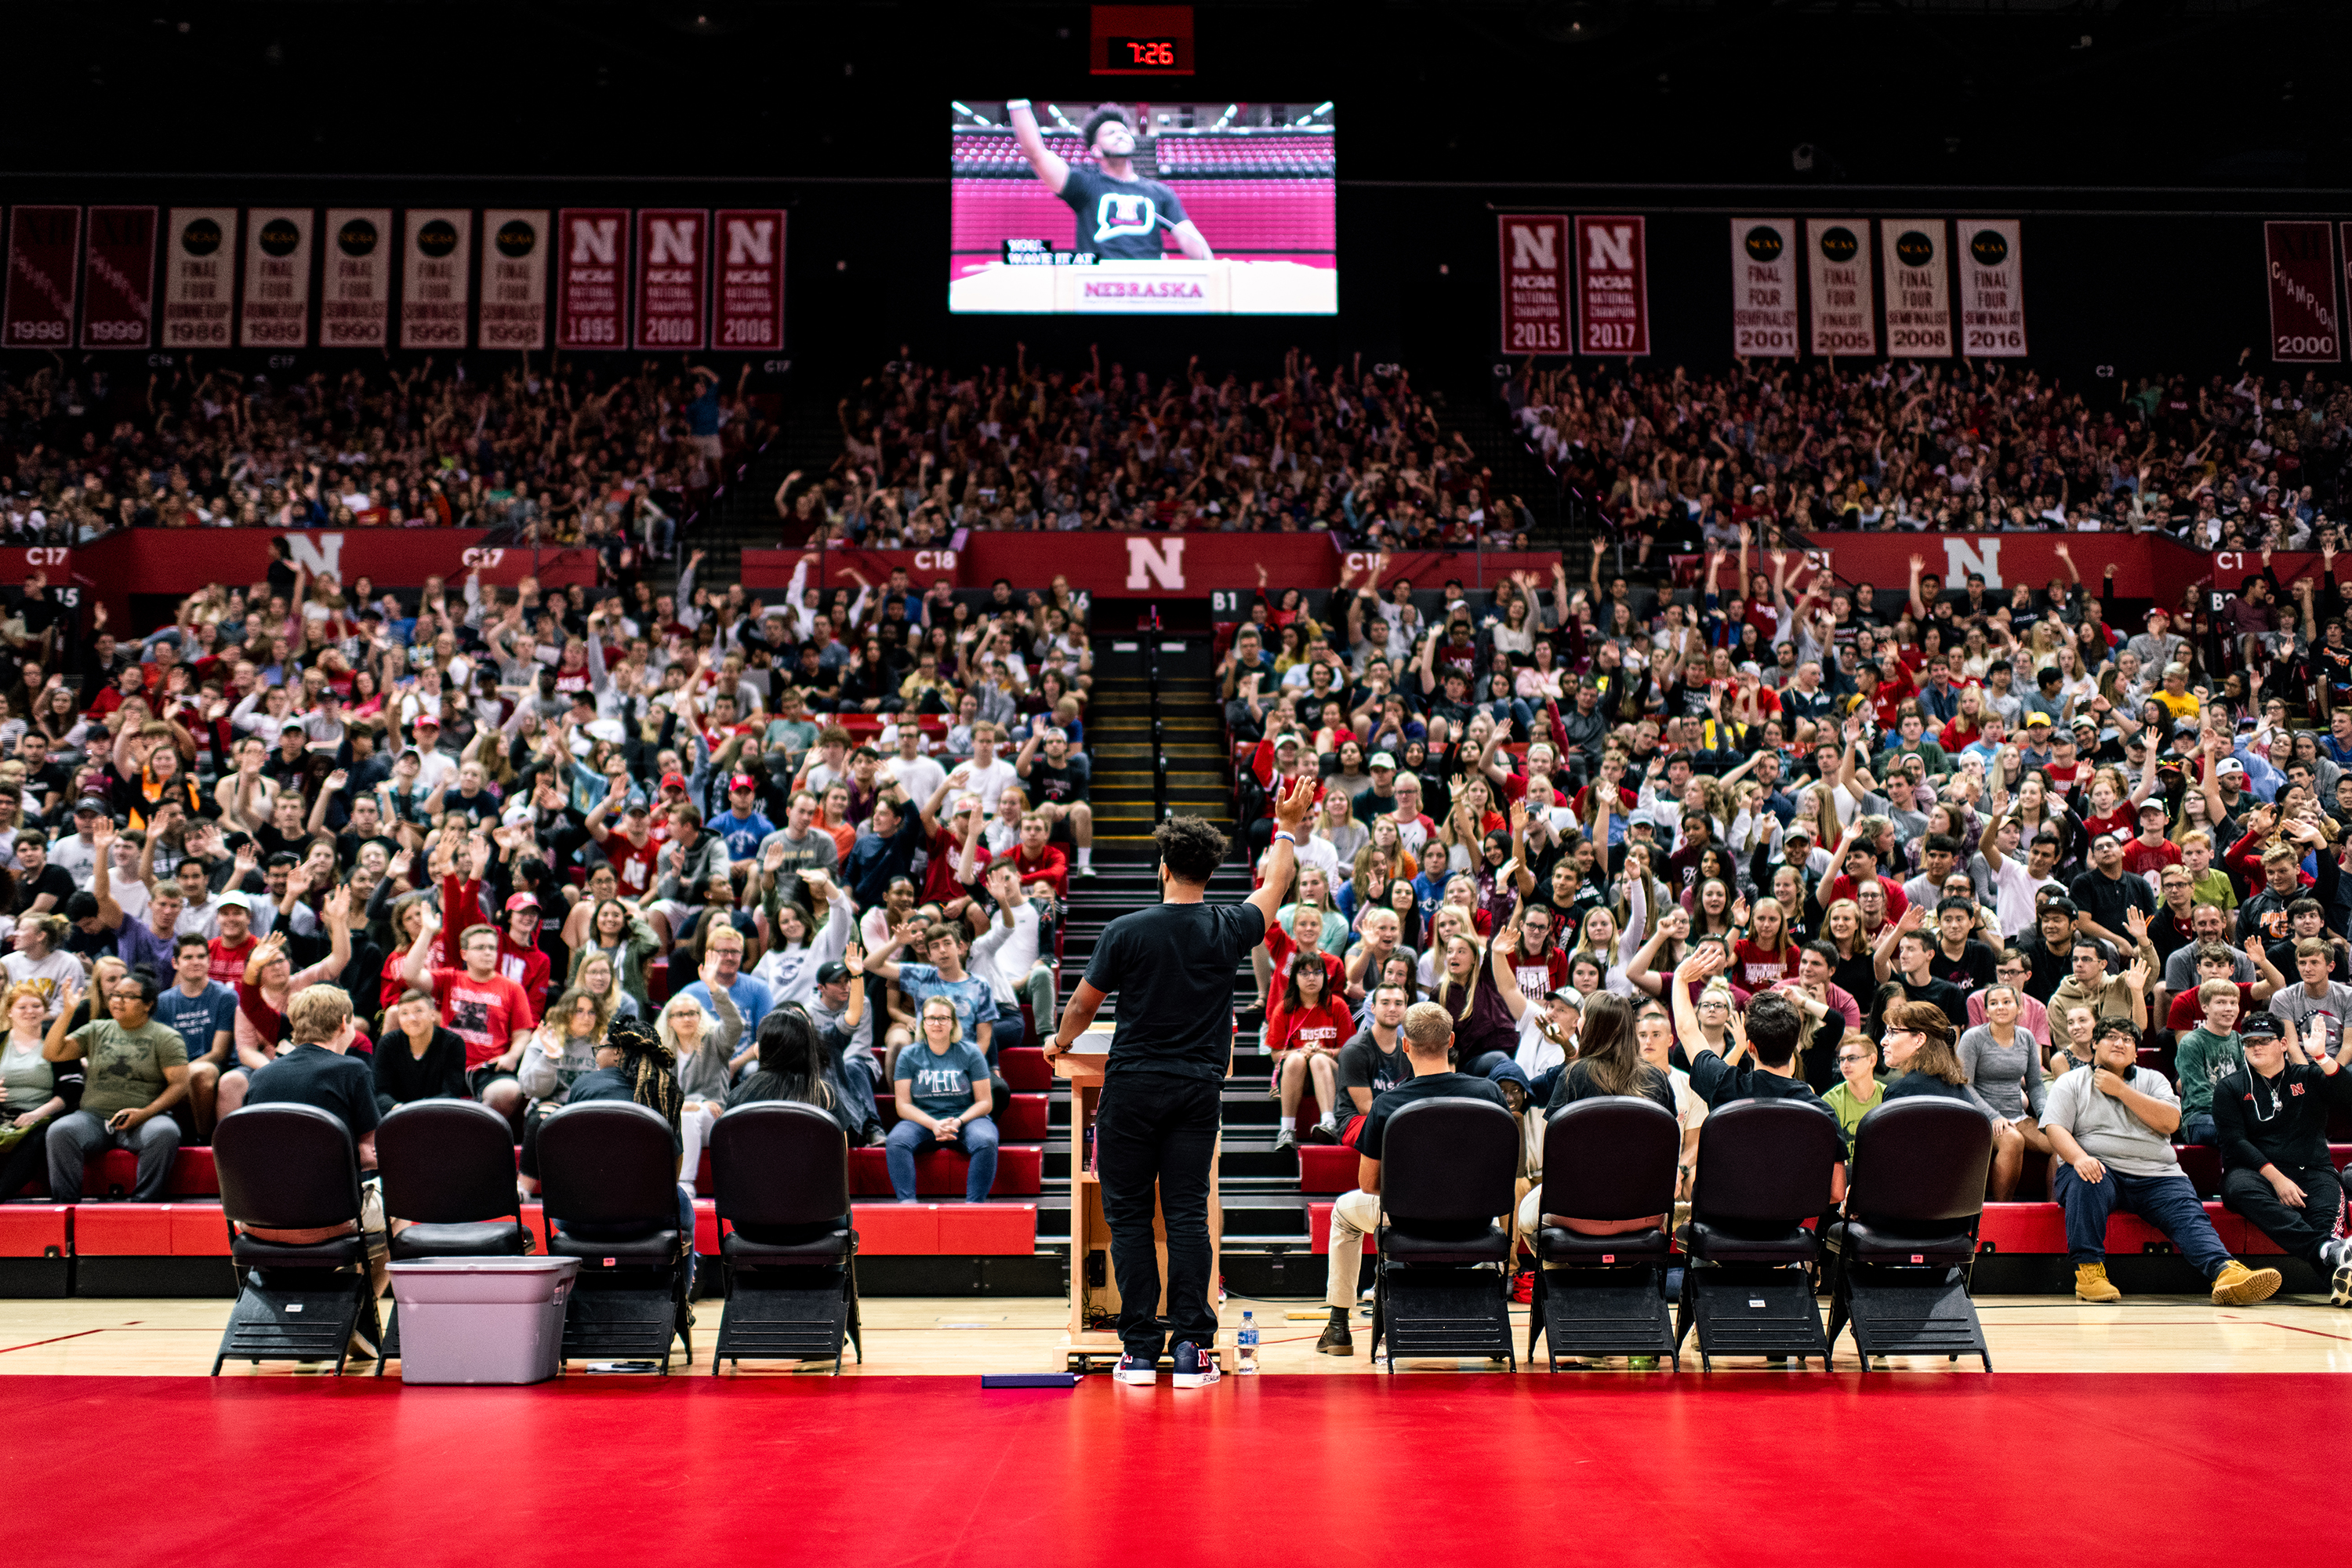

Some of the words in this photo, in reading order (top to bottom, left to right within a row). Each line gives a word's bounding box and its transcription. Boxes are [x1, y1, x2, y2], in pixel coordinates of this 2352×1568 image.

[1127, 42, 1174, 65] 7:26
[571, 219, 618, 263] N
[648, 219, 696, 264] N
[727, 220, 773, 264] N
[1511, 224, 1557, 269] N
[1588, 225, 1633, 270] N
[1007, 252, 1054, 265] WAVE
[1054, 252, 1073, 265] IT
[1073, 252, 1096, 265] AT
[1748, 264, 1781, 283] FINAL
[1824, 267, 1857, 286] FINAL
[1898, 270, 1933, 288] FINAL
[1974, 270, 2007, 289] FINAL
[1083, 281, 1204, 298] NEBRASKA
[1748, 288, 1781, 307] FOUR
[1826, 289, 1857, 307] FOUR
[1902, 290, 1933, 307] FOUR
[1977, 290, 2008, 308] FOUR
[2272, 261, 2334, 332] CHAMPION
[12, 320, 65, 339] 1998
[89, 320, 143, 339] 1999
[171, 322, 225, 342] 1986
[568, 316, 615, 343] 1995
[645, 317, 695, 343] 2000
[724, 318, 772, 343] 2006
[1513, 322, 1561, 347] 2015
[1589, 322, 1636, 347] 2017
[1740, 330, 1794, 347] 2001
[1818, 331, 1870, 347] 2005
[1894, 329, 1946, 347] 2008
[1969, 329, 2021, 348] 2016
[2278, 336, 2333, 354] 2000
[764, 359, 792, 372] C17
[1493, 364, 1512, 376] C1
[2096, 365, 2114, 378] C2
[25, 546, 70, 566] C17
[284, 532, 344, 586] N
[461, 546, 504, 568] C17
[914, 550, 958, 571] C18
[1126, 537, 1185, 590] N
[1346, 552, 1386, 572] C1
[1943, 537, 2004, 590] N
[2216, 551, 2243, 570] C1
[1211, 592, 1238, 612] B1
[2307, 684, 2317, 702] N
[622, 857, 648, 891] N
[2290, 1083, 2305, 1096] N
[1198, 1349, 1208, 1366] N
